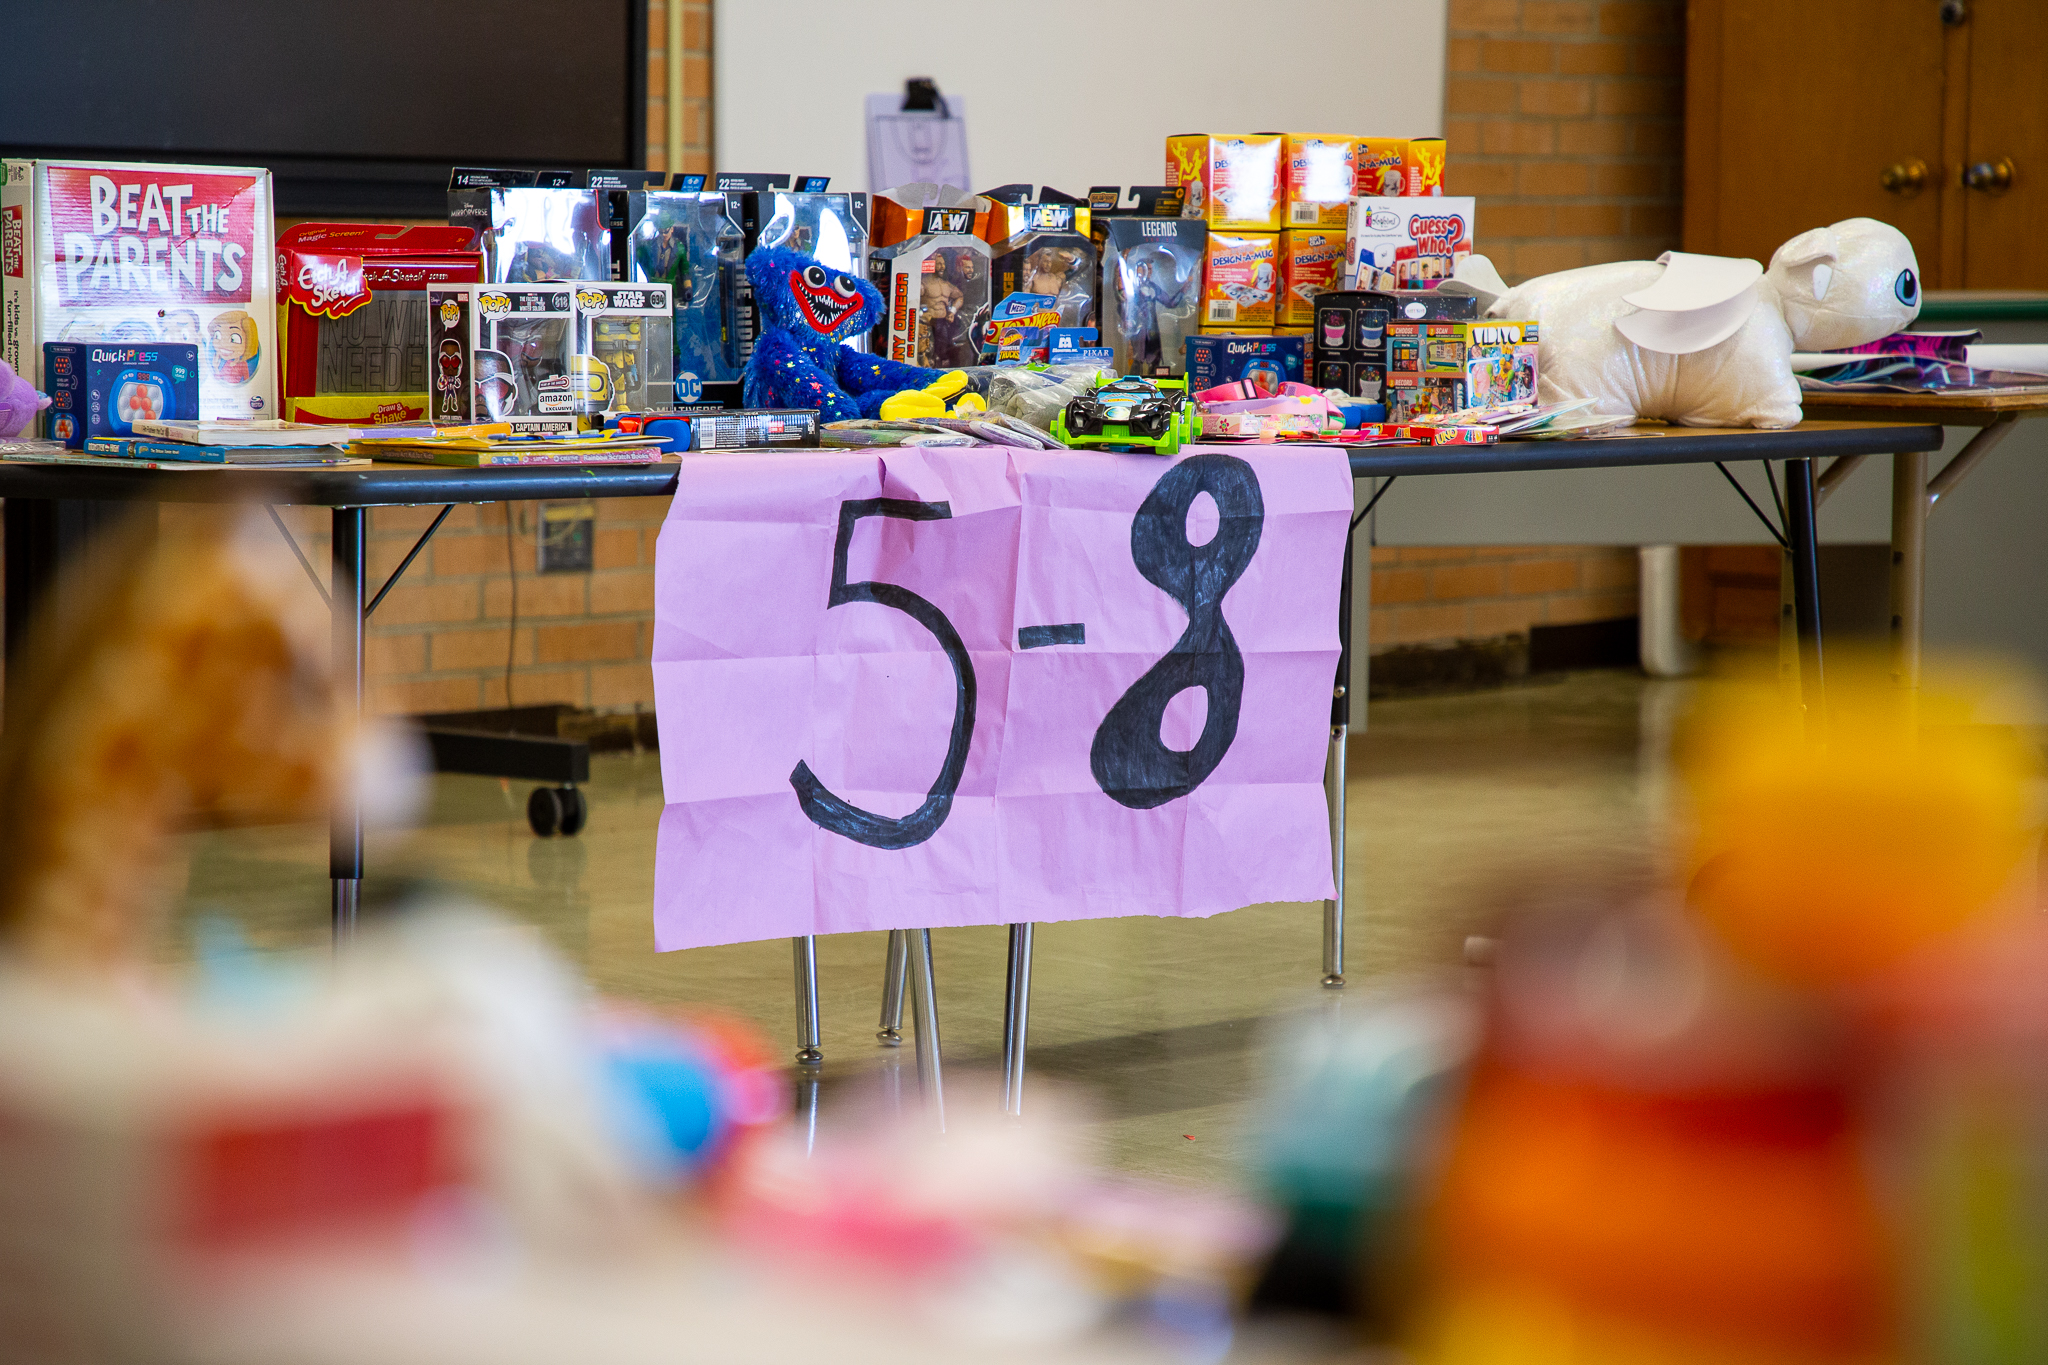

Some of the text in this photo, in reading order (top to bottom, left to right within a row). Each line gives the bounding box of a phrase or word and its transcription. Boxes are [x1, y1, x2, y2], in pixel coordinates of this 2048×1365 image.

[457, 175, 469, 185] 14
[552, 179, 566, 187] 12+
[591, 176, 603, 188] 22
[719, 178, 730, 190] 22
[90, 175, 229, 236] BEAT THE
[731, 201, 741, 209] 12+
[854, 201, 864, 210] 12+
[930, 213, 967, 231] AEW
[1032, 208, 1067, 227] AEW
[299, 228, 327, 238] Original
[1141, 221, 1178, 237] LEGENDS
[3, 210, 14, 274] PARENTS
[13, 219, 22, 256] BEAT
[298, 233, 327, 243] Magic
[63, 231, 246, 297] PARENTS
[1212, 249, 1274, 267] DESIGN-A-MUG
[1294, 250, 1345, 265] DESIGN-A-M
[298, 258, 349, 290] Etch A
[363, 271, 377, 281] tch
[311, 277, 362, 307] Sketch
[613, 291, 646, 300] STAR
[651, 294, 665, 305] 634
[478, 295, 511, 314] POP!
[576, 292, 608, 309] POP!
[612, 298, 646, 308] WARS
[894, 272, 909, 332] OMEGA
[440, 303, 460, 322] POP!
[906, 307, 917, 358] AS AKUMA
[999, 350, 1020, 360] TRUCKS
[1083, 349, 1110, 357] PIXAR
[321, 346, 429, 393] NEEDE
[676, 378, 702, 398] DC
[540, 394, 573, 402] amazon
[378, 404, 396, 414] Draw
[373, 410, 407, 425] Shake
[515, 422, 569, 432] CAPTAIN AMERICA
[1435, 428, 1458, 446] UNO
